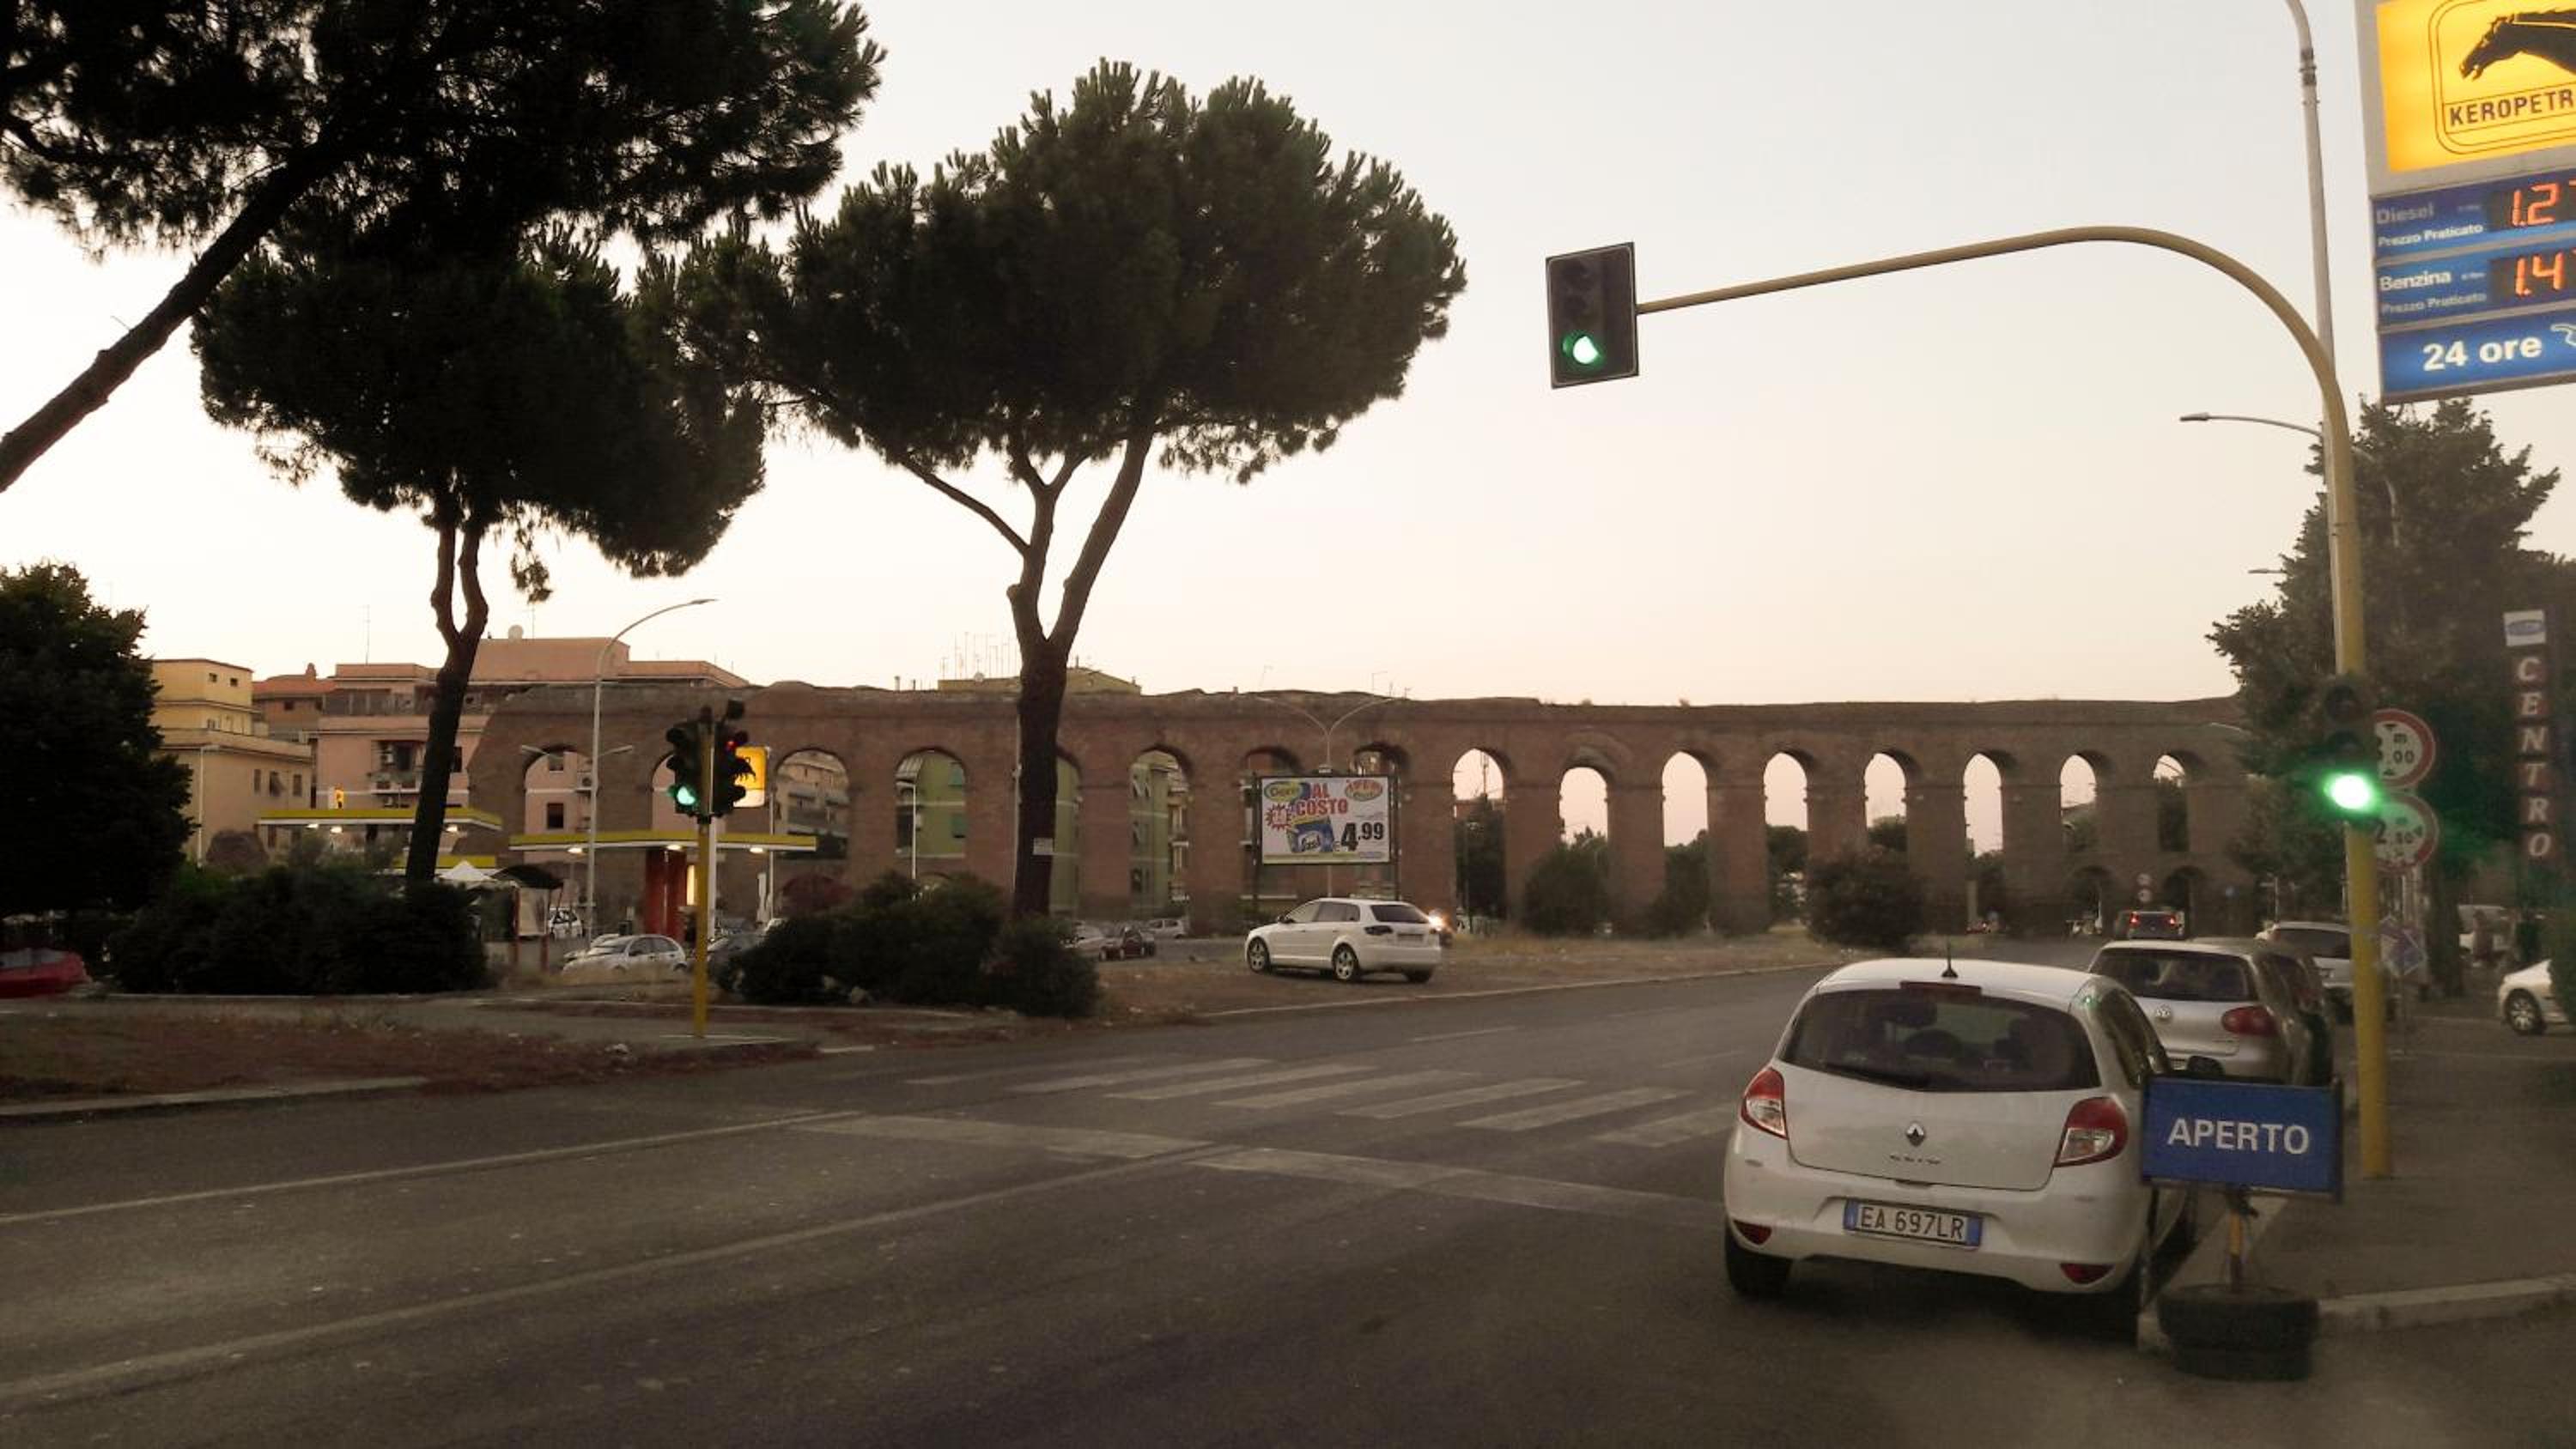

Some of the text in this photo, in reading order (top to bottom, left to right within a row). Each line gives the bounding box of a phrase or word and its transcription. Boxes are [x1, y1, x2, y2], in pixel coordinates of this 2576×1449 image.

[2450, 88, 2574, 126] KEROPETR
[2377, 178, 2576, 227] Diesel 1.2
[2378, 223, 2484, 246] Prezzo Praticato
[2379, 248, 2576, 296] Benzina 1.4
[2381, 293, 2488, 314] Prezzo Praticato
[2423, 336, 2543, 372] 24 ore
[2517, 656, 2552, 858] CENTRO
[1296, 798, 1349, 816] COSTO
[1312, 783, 1330, 798] AL
[2166, 1117, 2311, 1155] APERTO
[1861, 1206, 1965, 1240] EA 697LR
